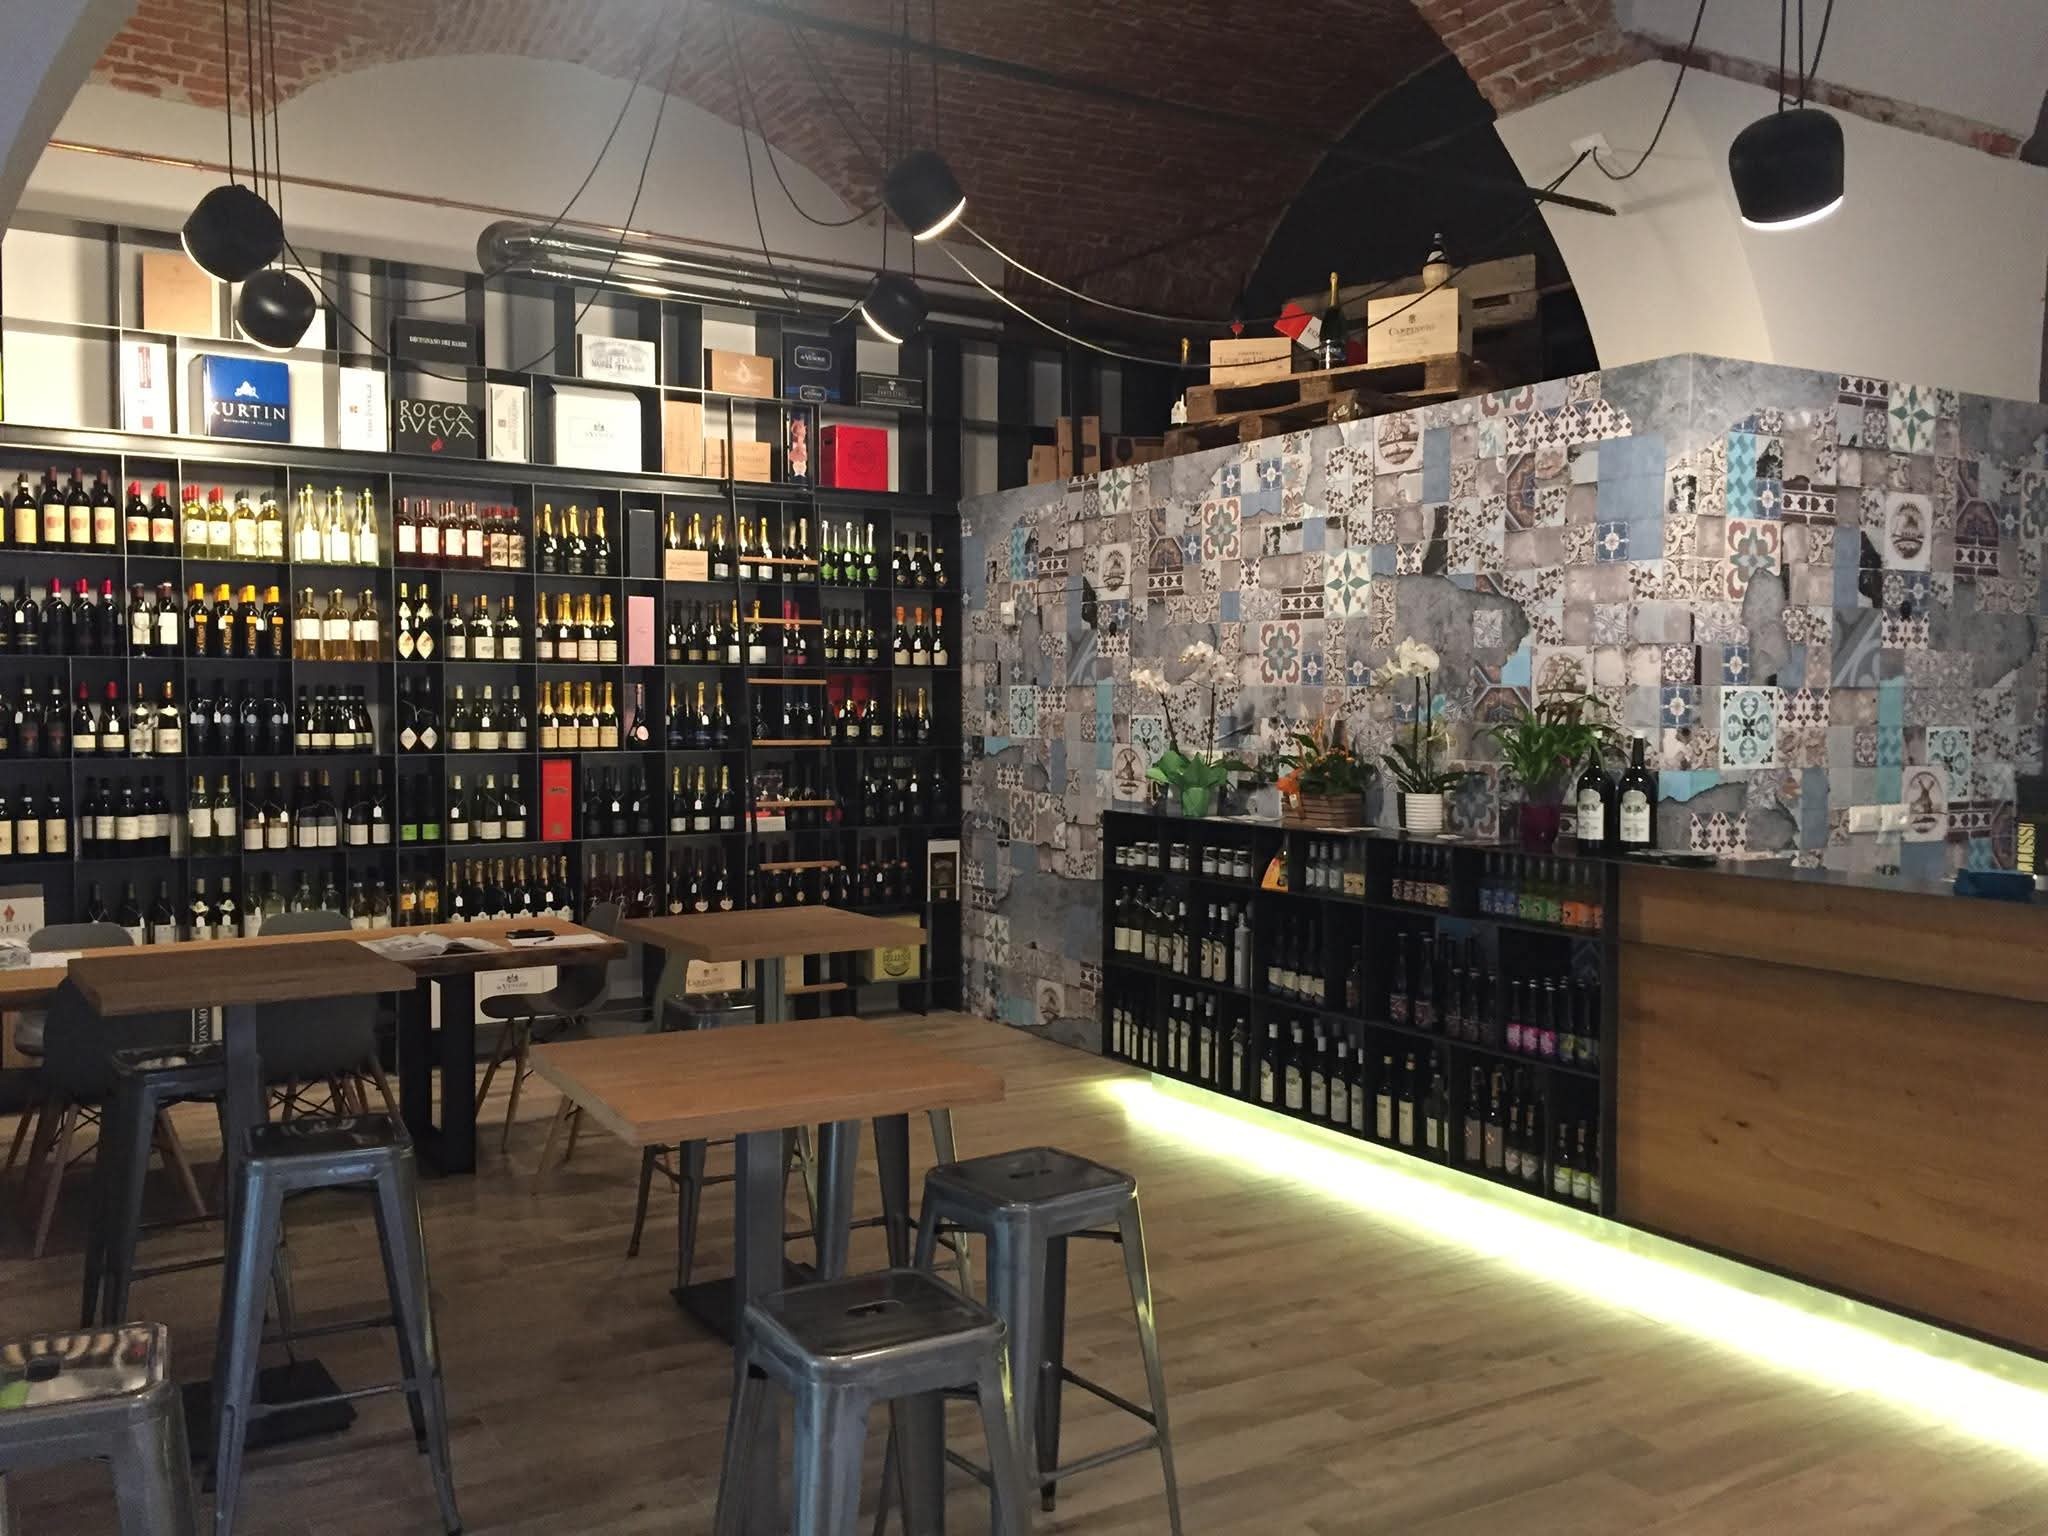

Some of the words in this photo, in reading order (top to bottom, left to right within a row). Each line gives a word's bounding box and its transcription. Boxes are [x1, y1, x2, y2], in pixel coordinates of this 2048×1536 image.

[209, 401, 287, 420] KURTIN
[400, 400, 475, 424] ROCCA
[399, 415, 476, 440] SVEVA
